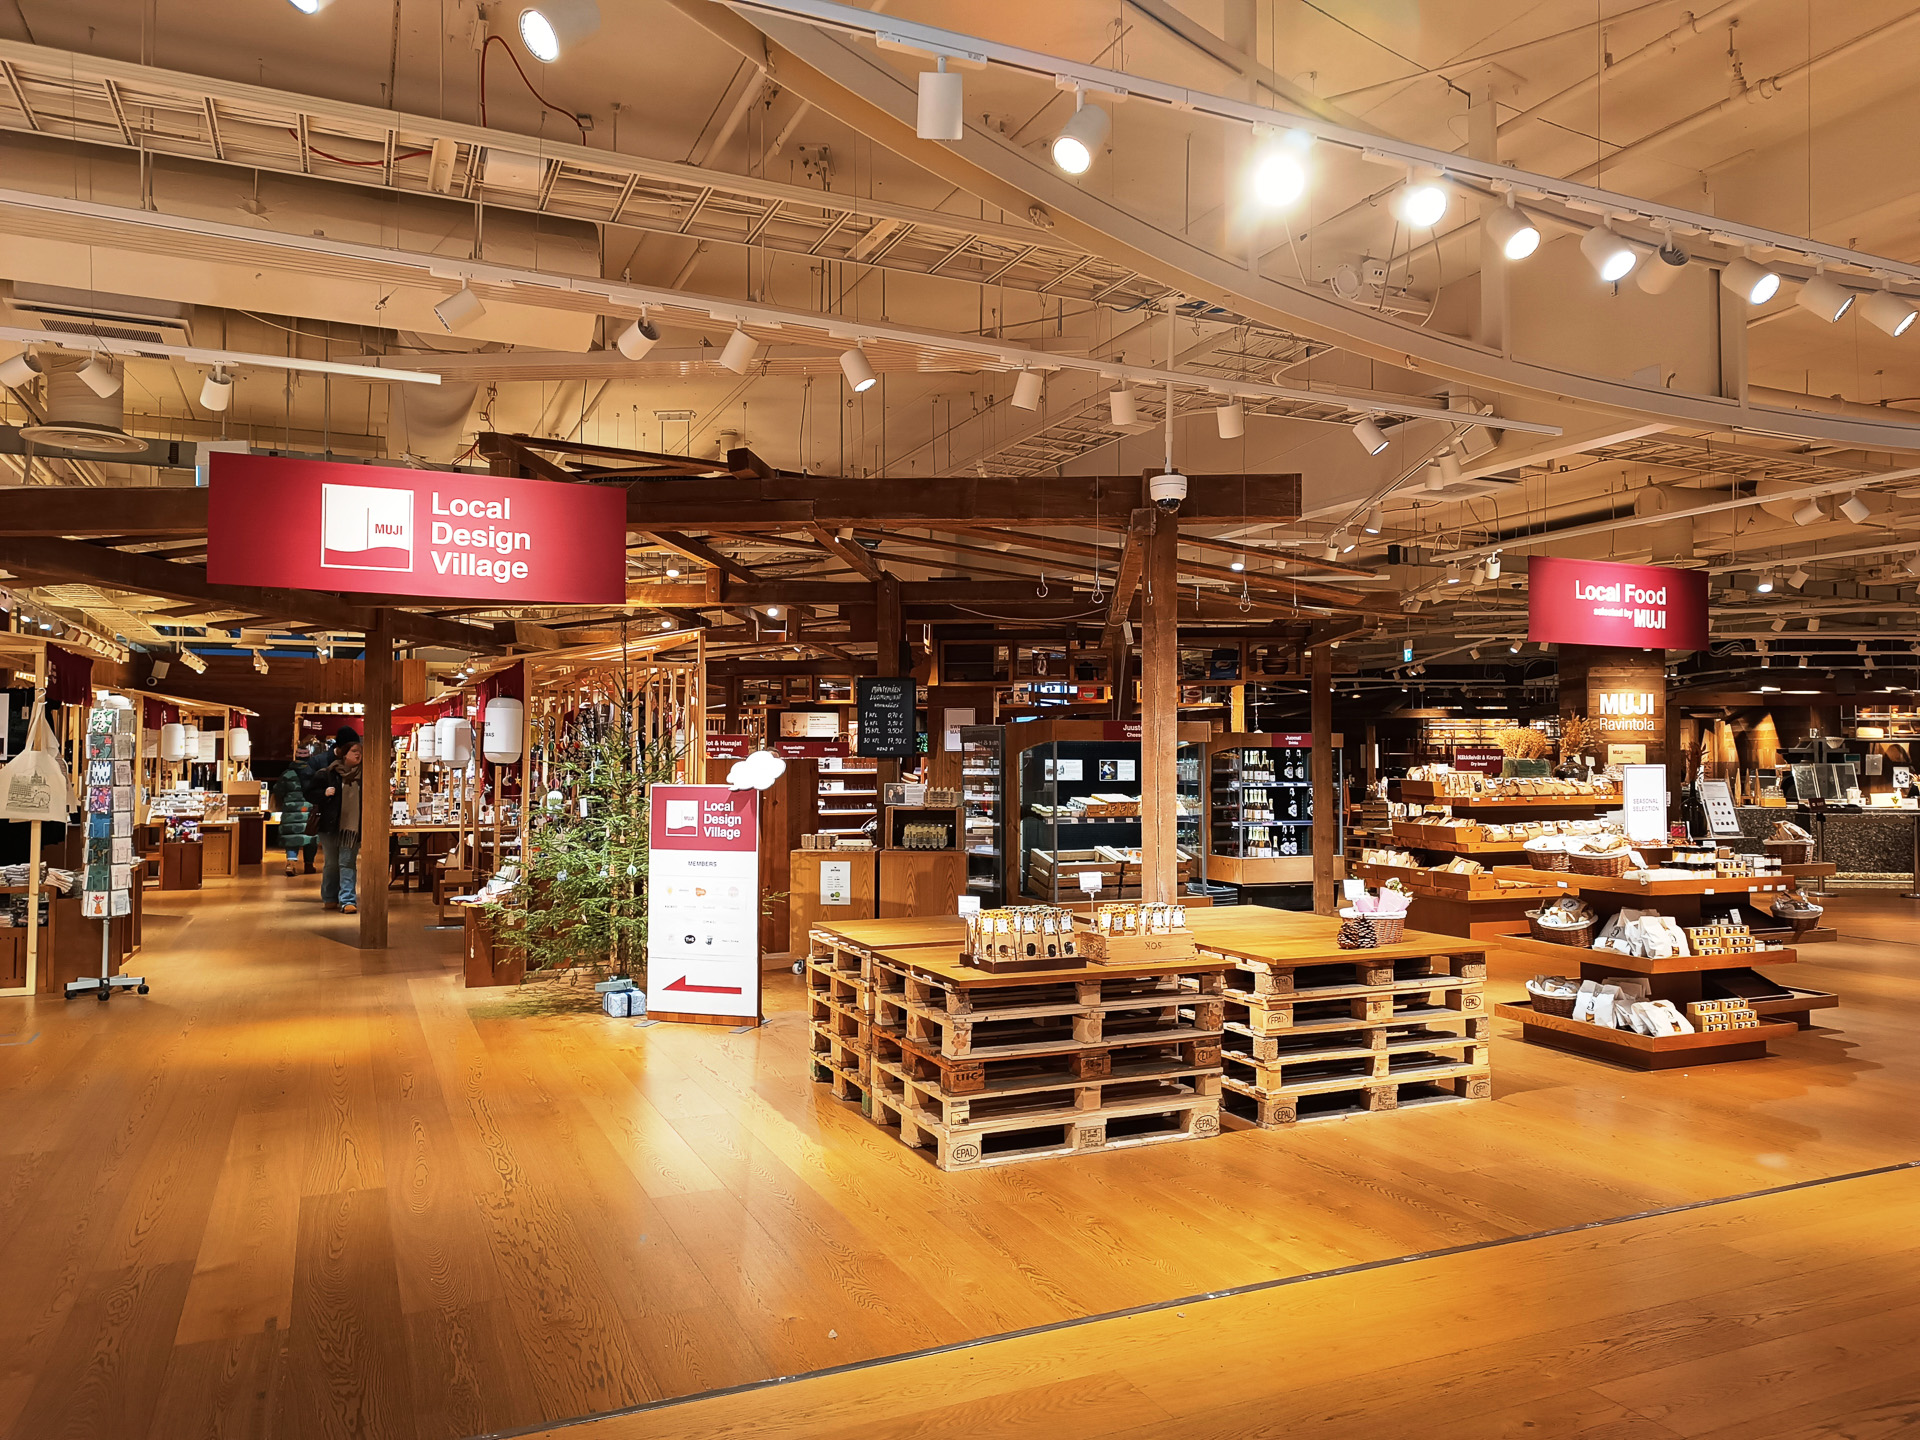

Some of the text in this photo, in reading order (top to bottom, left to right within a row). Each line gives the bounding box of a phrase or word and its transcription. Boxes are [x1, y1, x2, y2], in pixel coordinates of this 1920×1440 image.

[432, 491, 511, 520] Local
[375, 523, 404, 536] MUJI
[431, 521, 532, 552] Design
[430, 550, 530, 584] Village
[1575, 580, 1667, 606] Local Food
[1593, 606, 1667, 629] selected by MUJI
[1599, 693, 1655, 715] MUJI
[1599, 717, 1655, 731] Ravintola
[720, 740, 742, 748] Hunajat
[703, 800, 734, 811] Local
[703, 813, 742, 826] Design
[703, 826, 741, 840] Village
[1277, 1109, 1293, 1119] EPAL
[1198, 1118, 1216, 1129] EPAL
[956, 1147, 974, 1159] EPAL
